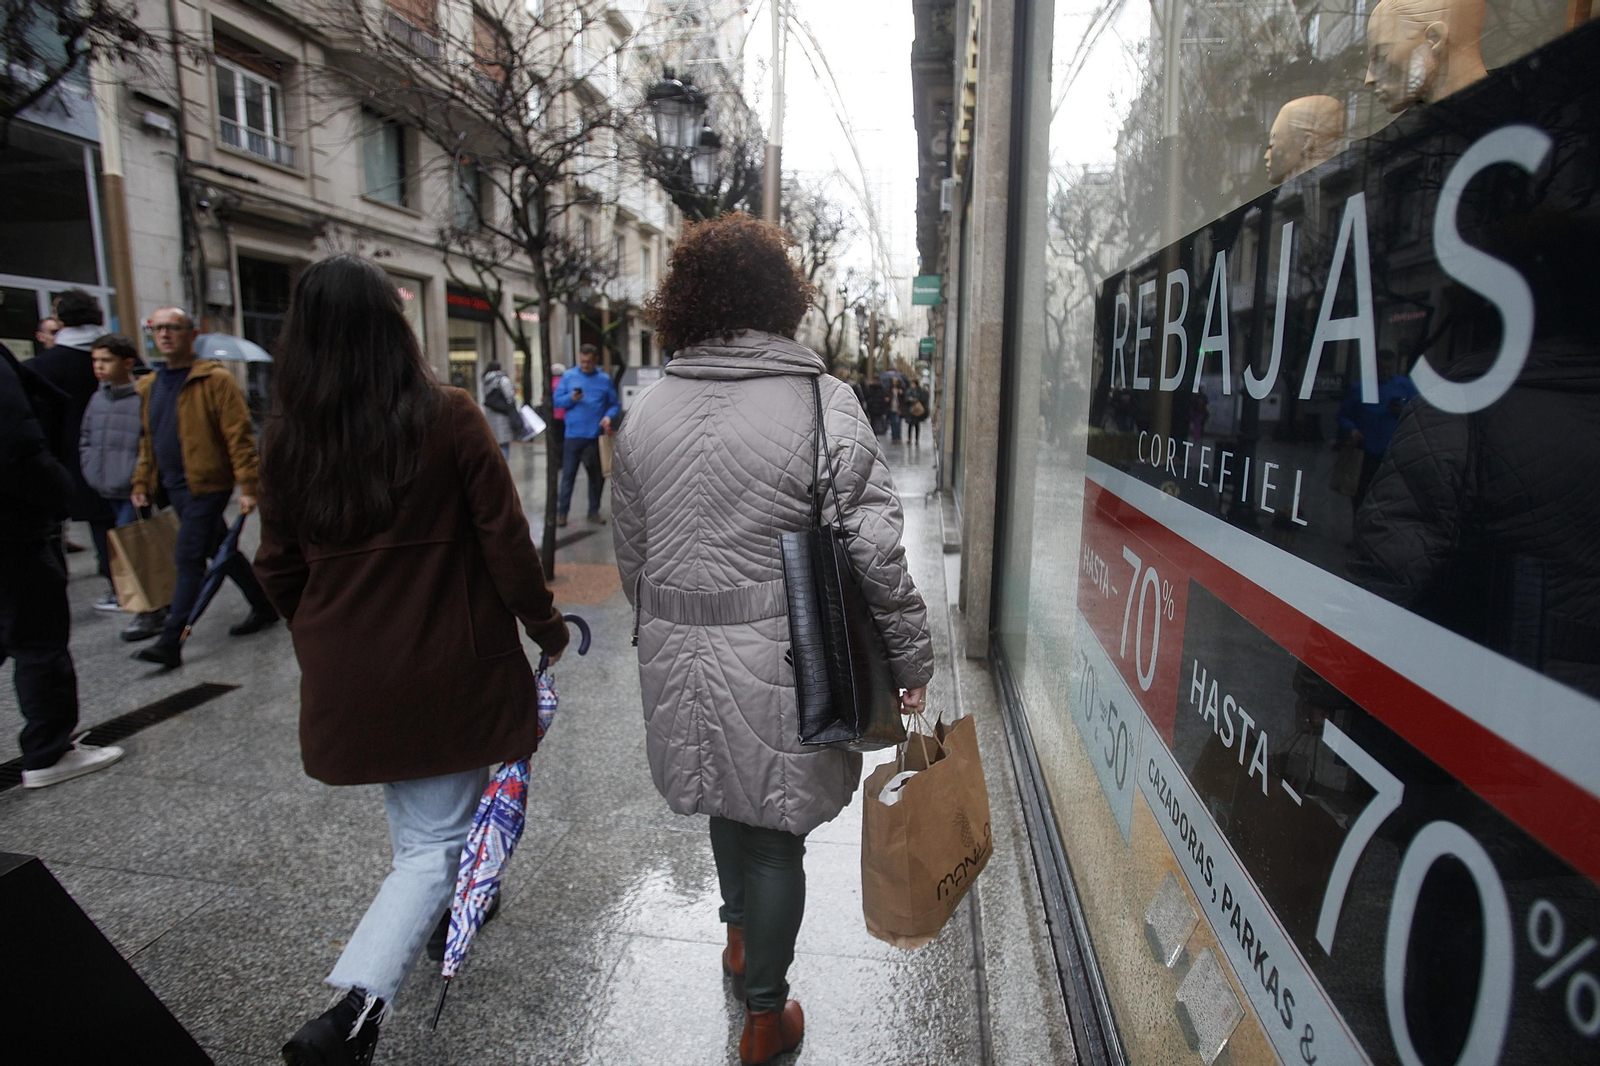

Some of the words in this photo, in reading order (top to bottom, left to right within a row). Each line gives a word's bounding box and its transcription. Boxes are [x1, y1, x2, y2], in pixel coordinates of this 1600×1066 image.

[1110, 124, 1553, 414] REBAJAS
[1138, 429, 1308, 526] CORTEFIEL
[1083, 543, 1109, 600] HASTA
[1190, 659, 1268, 797] HASTA
[1147, 757, 1217, 903] CAZADORAS,
[1220, 883, 1294, 1031] PARKAS
[1299, 1023, 1317, 1066] &
